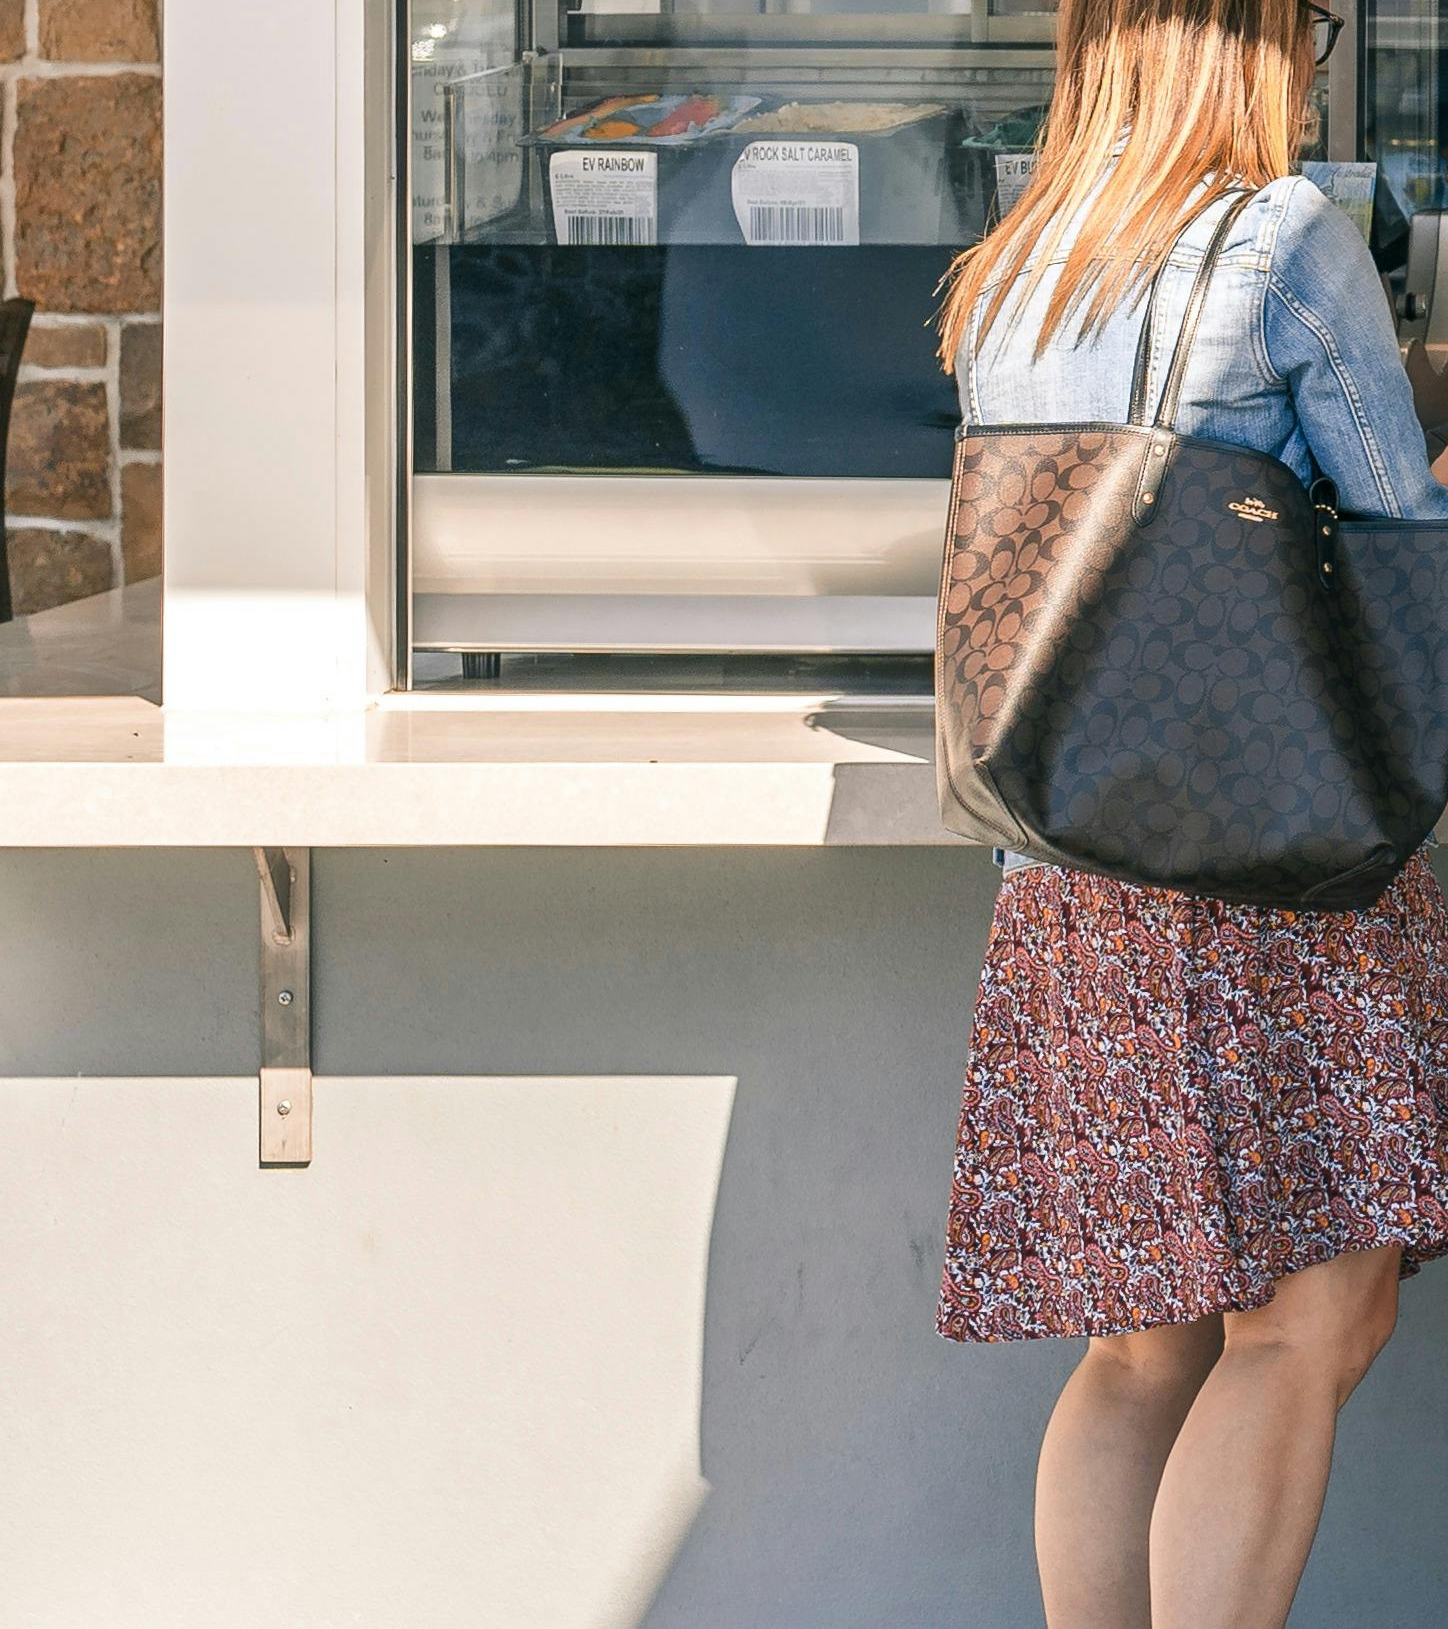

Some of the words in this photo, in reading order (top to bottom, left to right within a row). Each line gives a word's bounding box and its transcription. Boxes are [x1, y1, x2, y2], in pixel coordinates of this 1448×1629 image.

[753, 147, 779, 161] ROCK
[782, 147, 805, 161] SALT
[808, 147, 852, 161] CARAMEL
[583, 157, 596, 171] EV
[598, 157, 645, 171] RAINBOW
[1228, 502, 1279, 520] COACH
